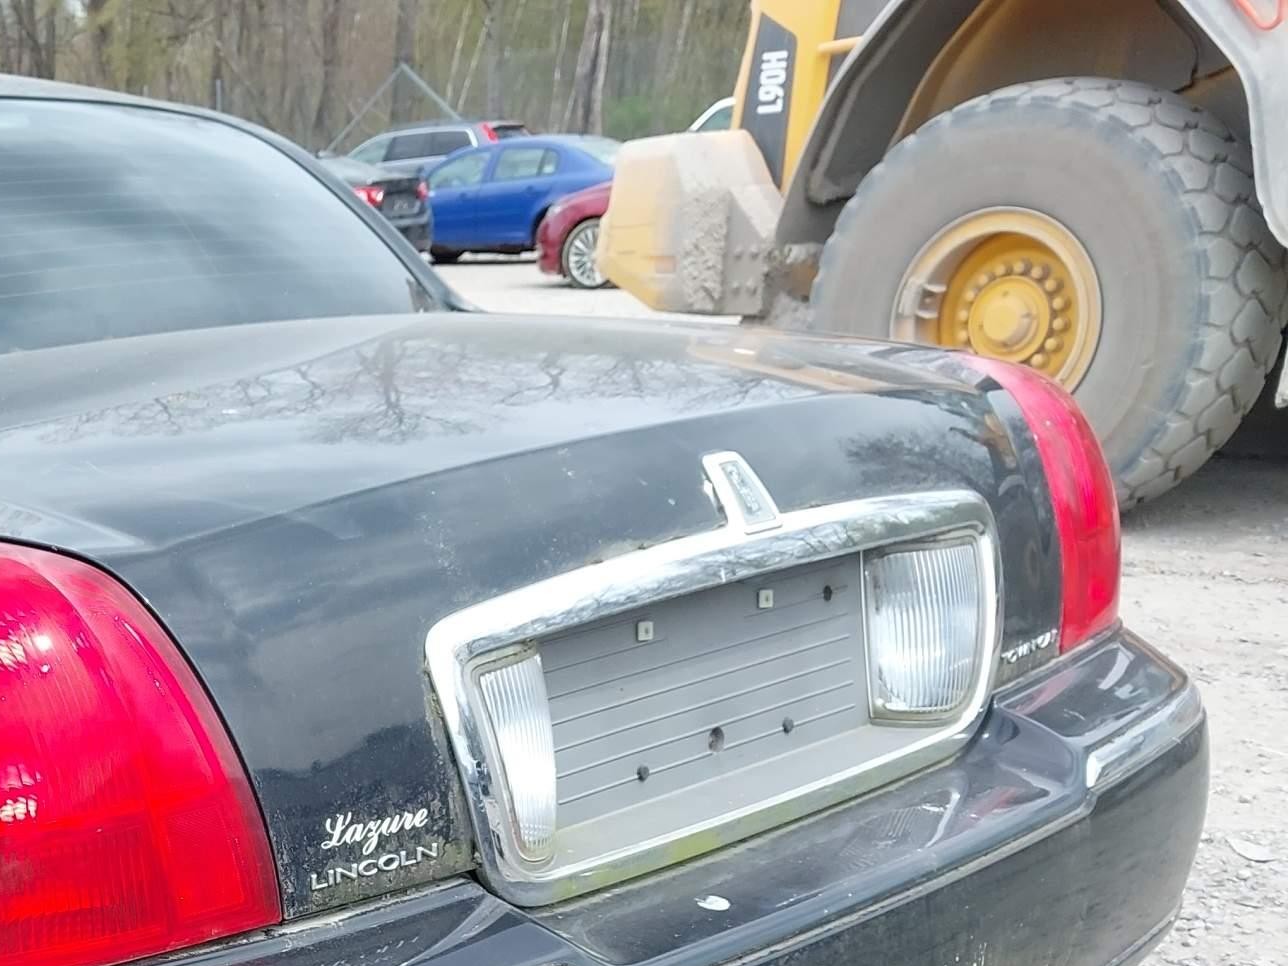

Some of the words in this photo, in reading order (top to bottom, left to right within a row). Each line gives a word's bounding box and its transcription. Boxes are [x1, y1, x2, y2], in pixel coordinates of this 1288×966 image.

[756, 50, 789, 114] L90H
[321, 808, 429, 856] Lazure
[311, 842, 438, 891] LINCOLN
